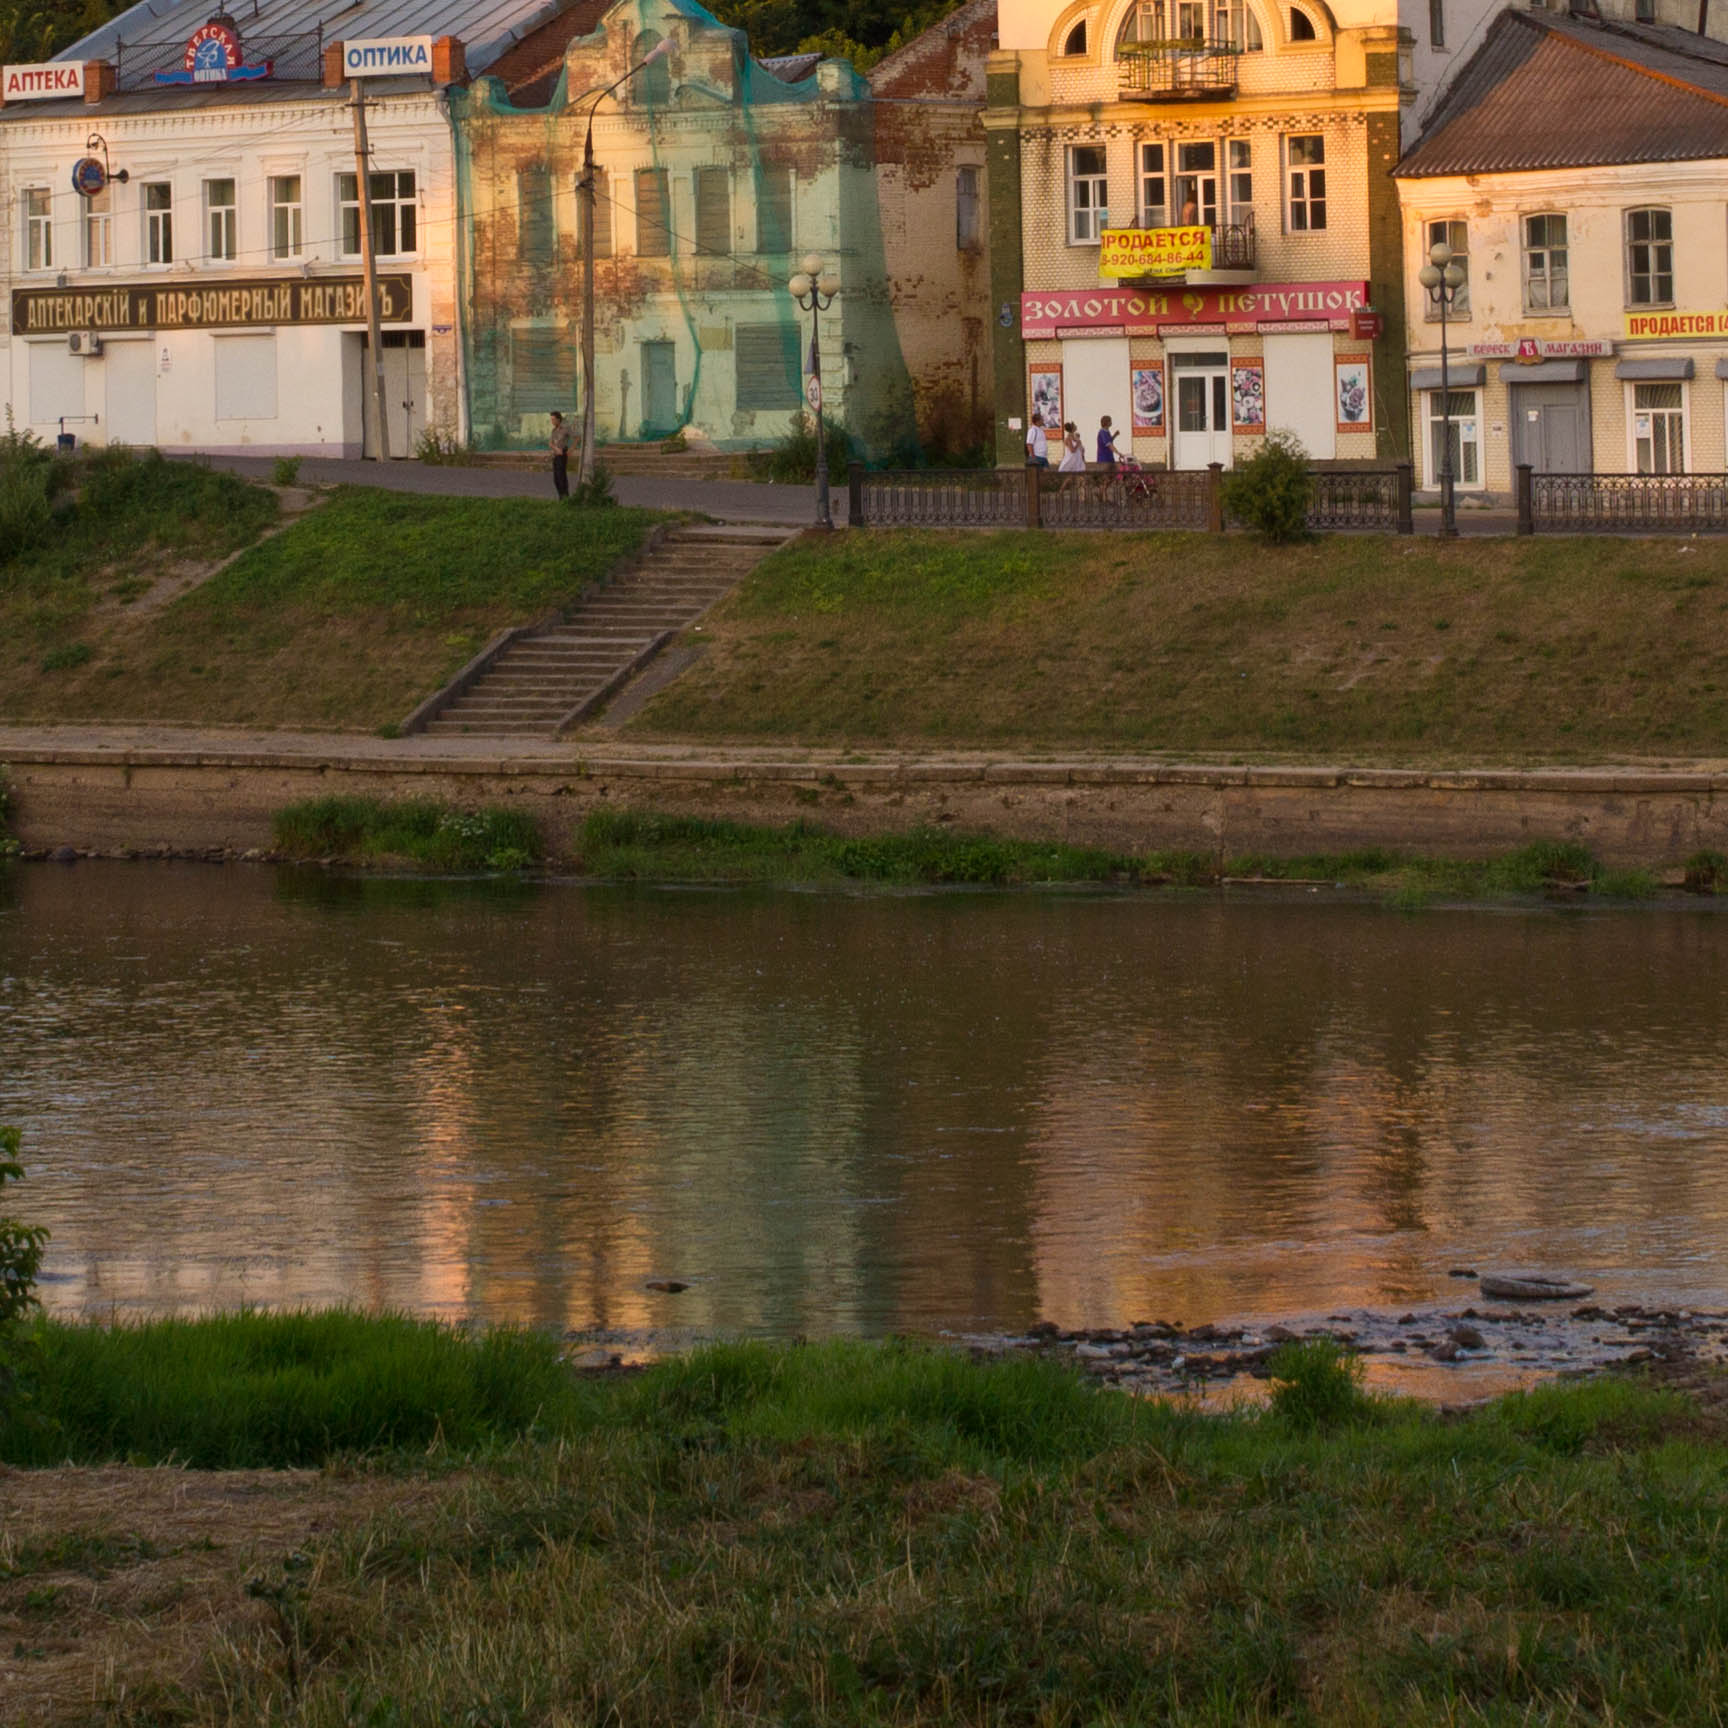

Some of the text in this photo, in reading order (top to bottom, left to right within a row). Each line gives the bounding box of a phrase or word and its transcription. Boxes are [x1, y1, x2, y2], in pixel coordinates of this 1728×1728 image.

[186, 27, 235, 68] ТВЕРСКАЯ
[347, 44, 428, 68] ОПТИКА
[7, 68, 79, 93] АПТЕКА
[156, 284, 292, 322] ПАРФЮМЕРНЫЙ
[300, 283, 392, 320] МАГАЗИЪ
[1025, 296, 1169, 321] ЗОЛОТОЙ
[1218, 290, 1362, 316] ПЕТУШОК
[1630, 315, 1714, 336] ПРОДАЕТСЯ
[1545, 343, 1602, 353] МАГАЗИН
